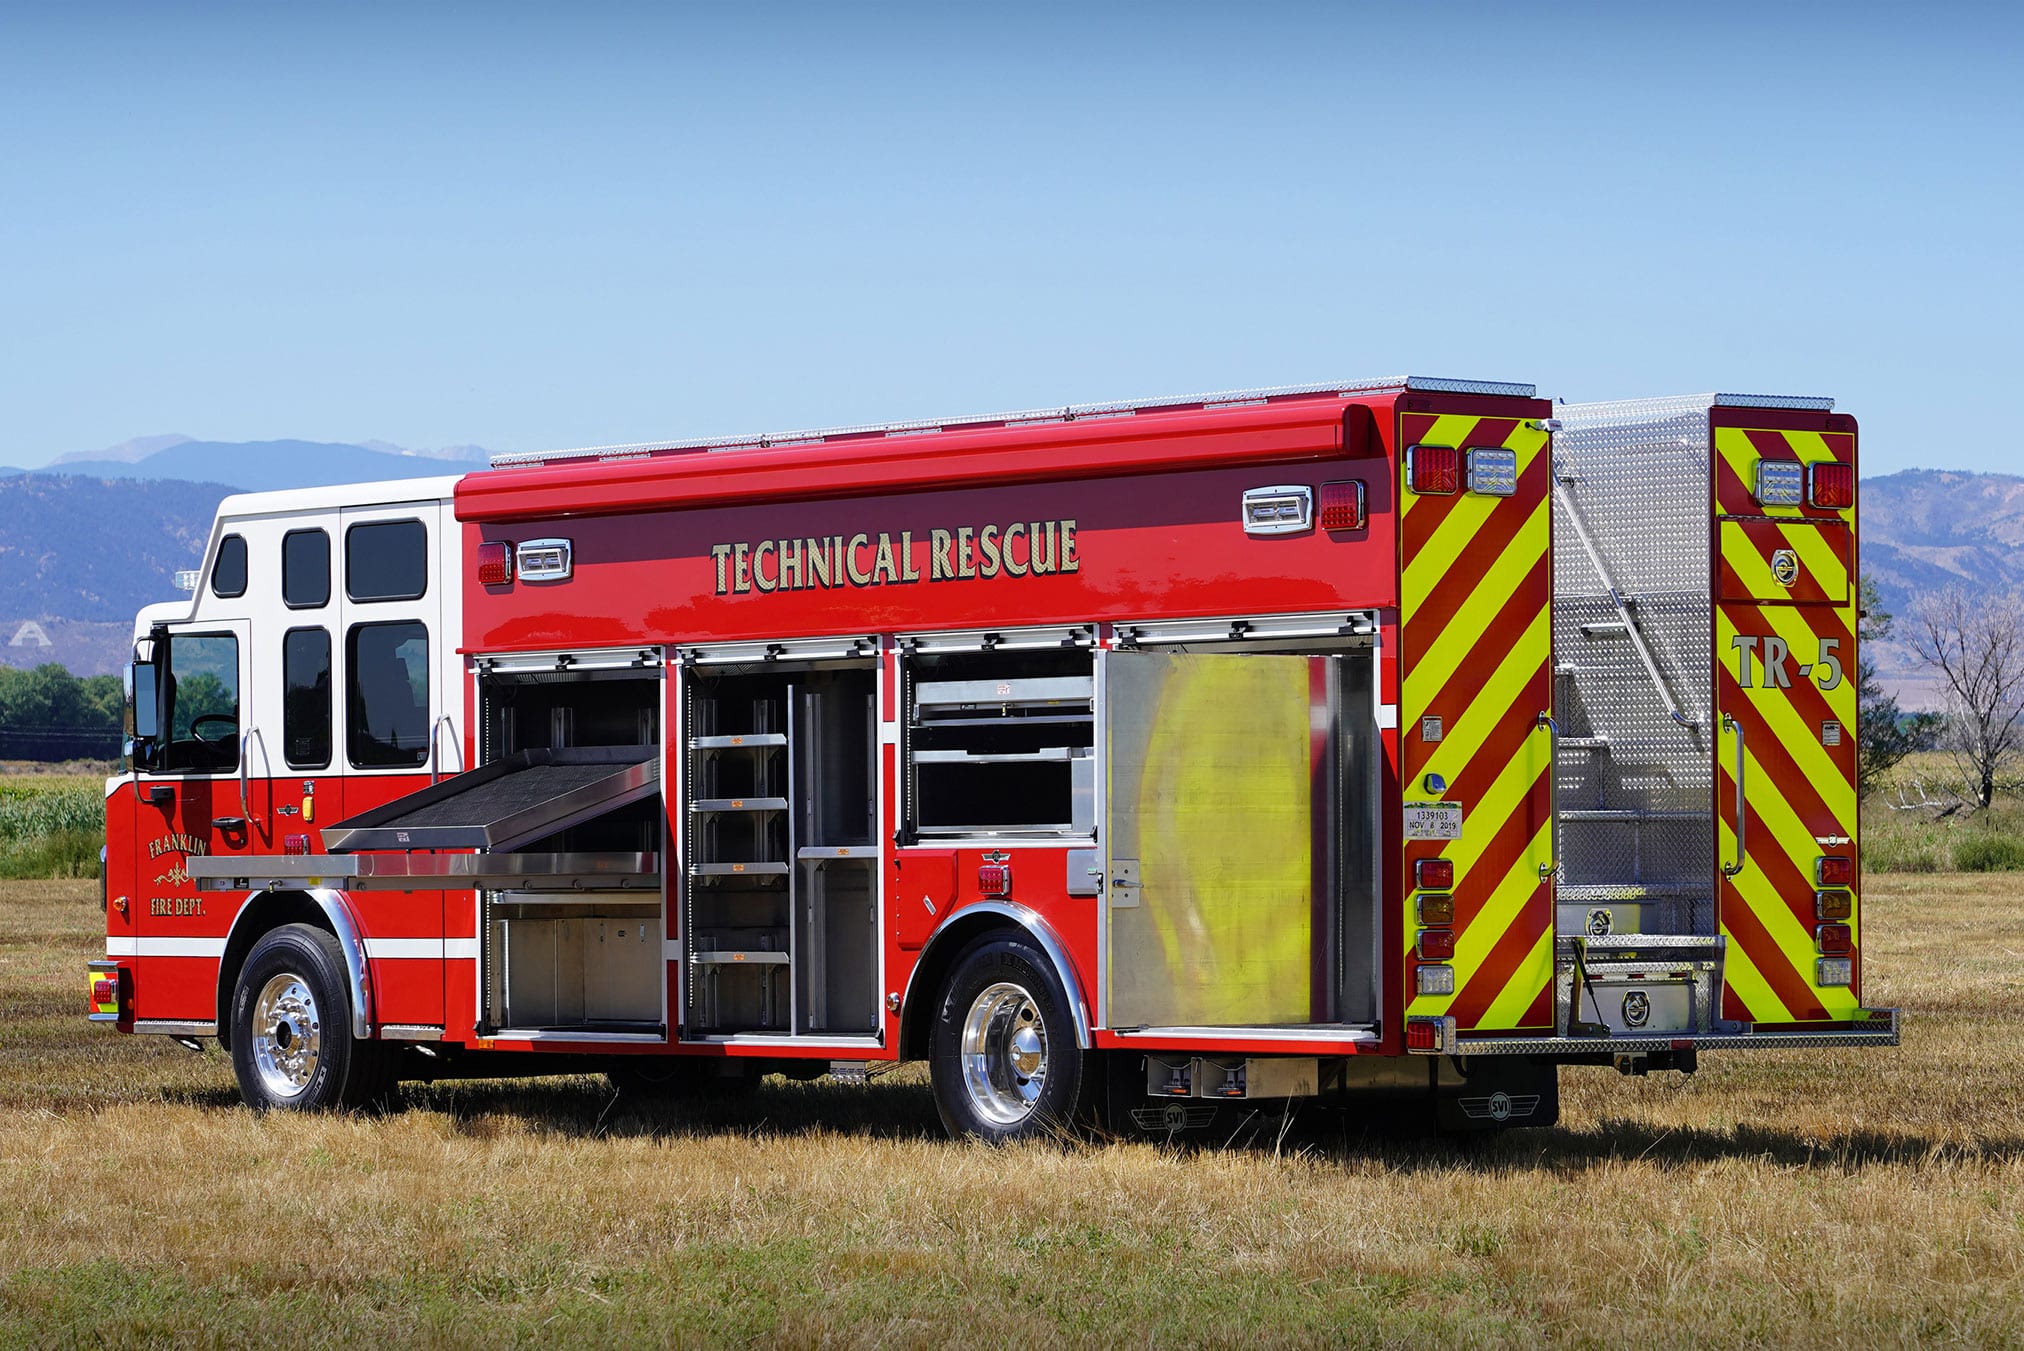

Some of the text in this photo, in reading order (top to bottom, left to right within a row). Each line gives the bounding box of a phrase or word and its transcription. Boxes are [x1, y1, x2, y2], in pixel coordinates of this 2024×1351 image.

[711, 519, 1080, 596] TECHNICAL RESCUE
[1409, 821, 1425, 829] NOV
[1440, 821, 1457, 830] 2019
[148, 834, 207, 860] FRANKLIN
[150, 898, 206, 916] FIRE DEPT.
[1489, 1099, 1508, 1114] SVI
[1166, 1112, 1184, 1124] SVI
